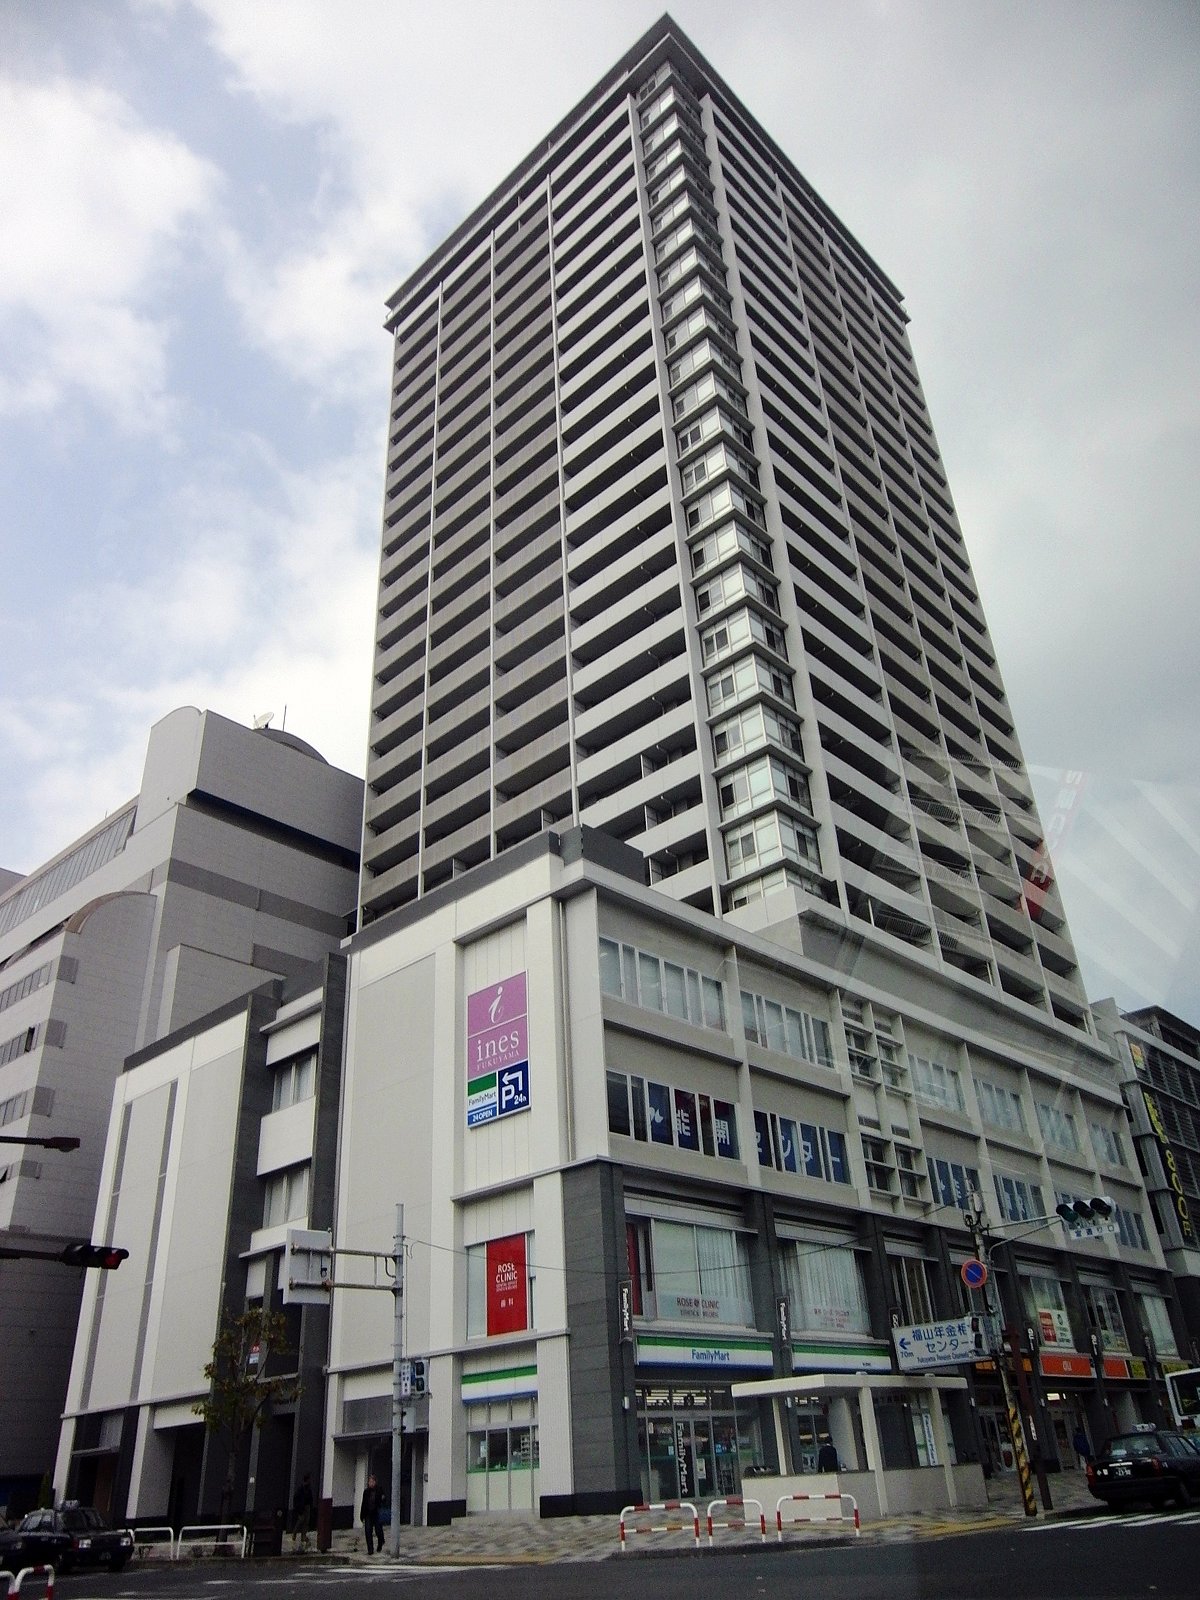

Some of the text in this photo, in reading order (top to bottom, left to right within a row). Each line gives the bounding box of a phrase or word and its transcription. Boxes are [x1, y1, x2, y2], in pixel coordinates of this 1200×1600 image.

[477, 1031, 520, 1063] ines
[476, 1051, 520, 1072] FUKUYAMA
[468, 1091, 497, 1106] FamilyMart
[501, 1084, 515, 1109] P
[497, 1262, 515, 1274] ROSE
[495, 1271, 518, 1284] CLINIC
[691, 1348, 730, 1363] FamilyMart
[676, 1422, 689, 1494] FamilyMart
